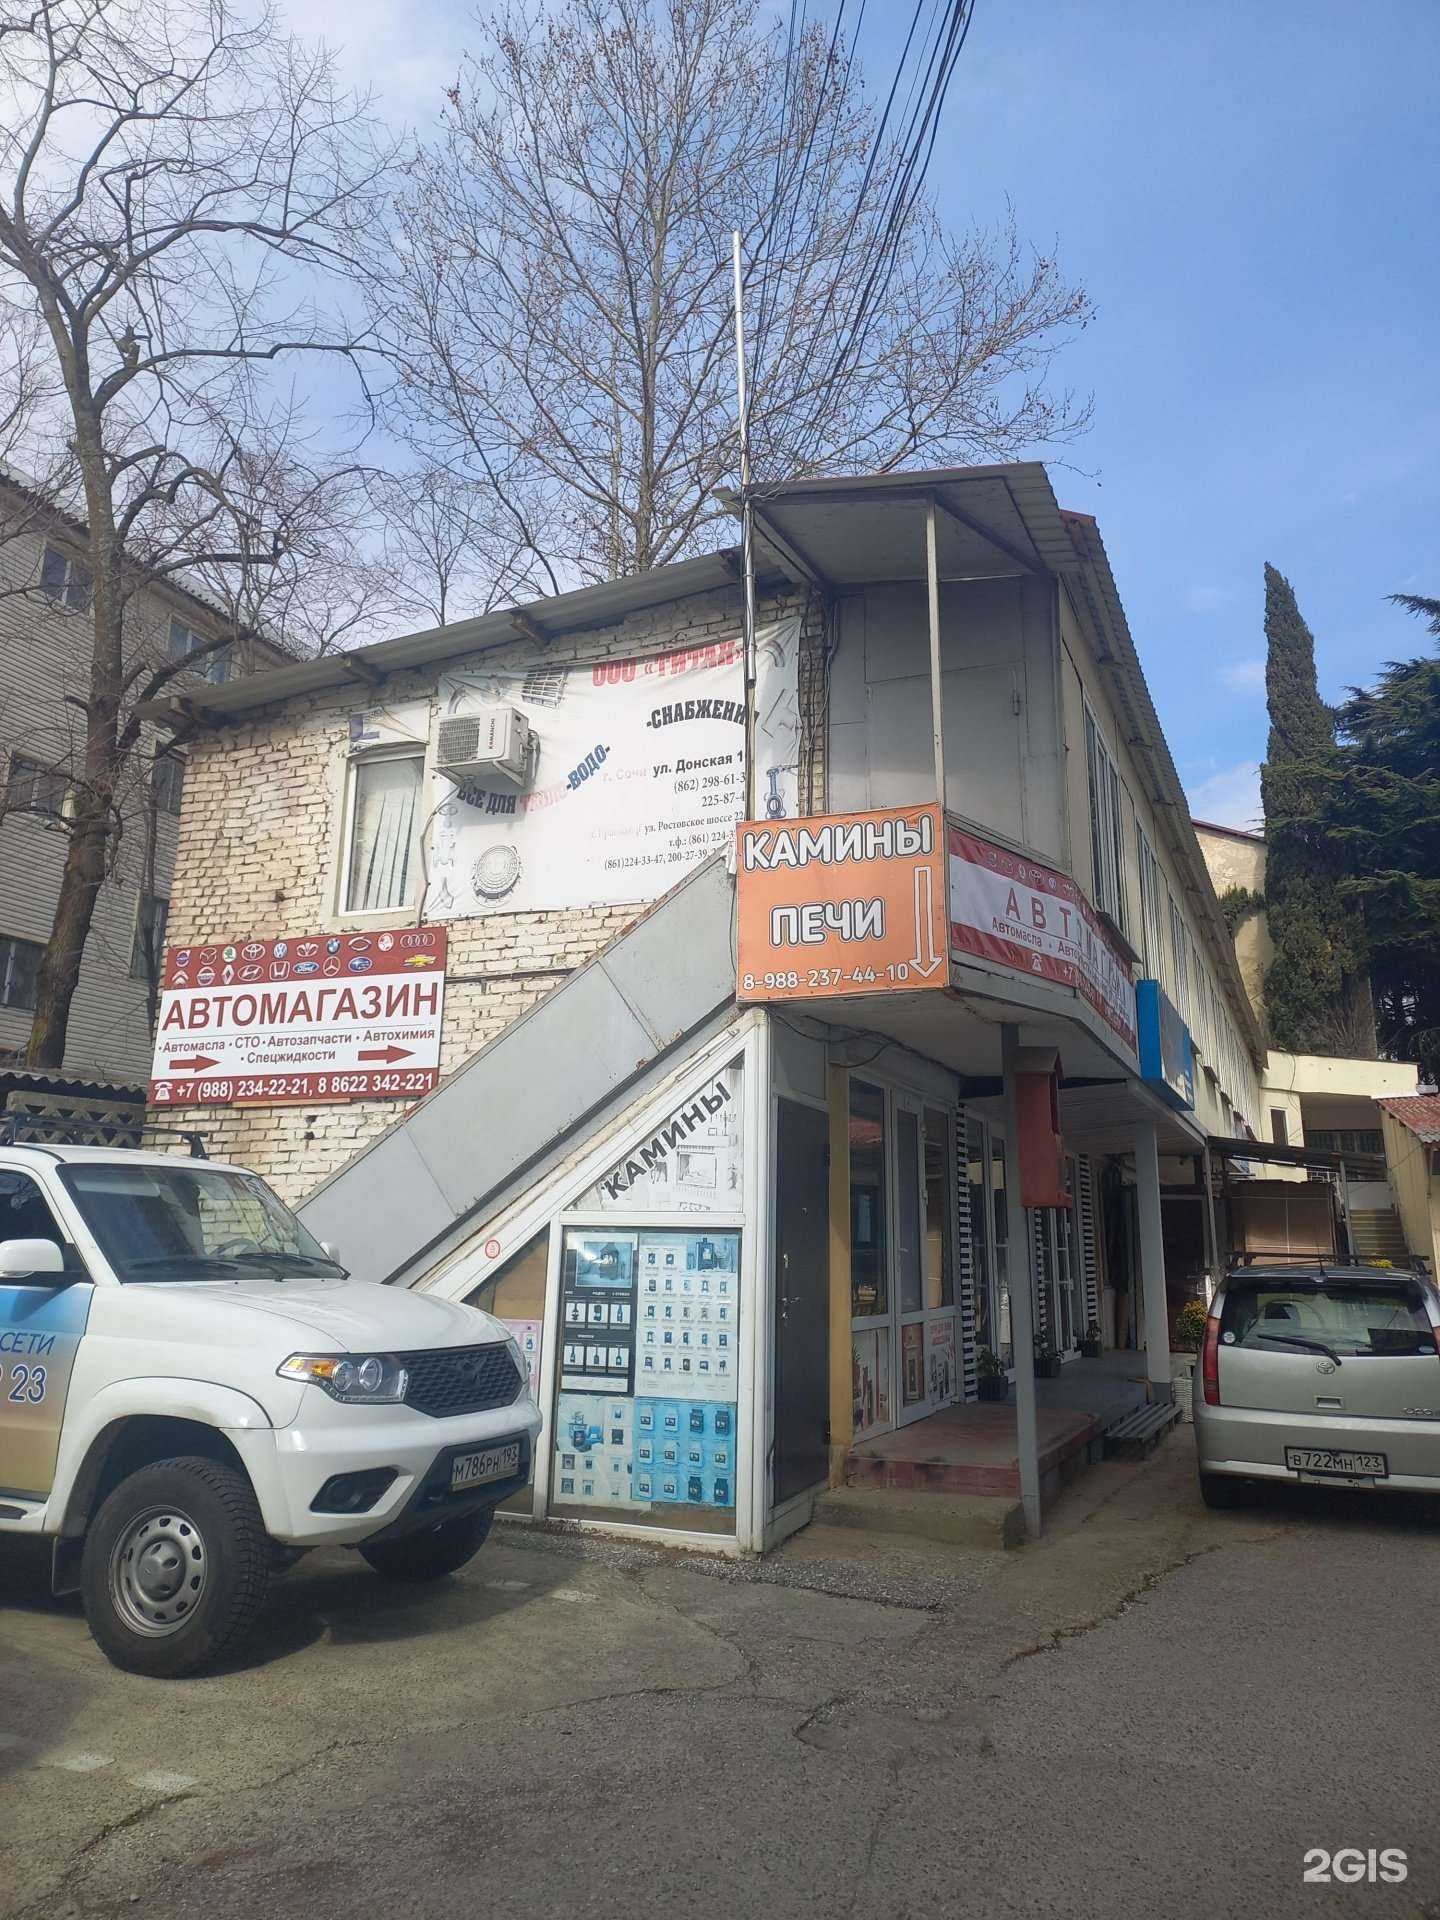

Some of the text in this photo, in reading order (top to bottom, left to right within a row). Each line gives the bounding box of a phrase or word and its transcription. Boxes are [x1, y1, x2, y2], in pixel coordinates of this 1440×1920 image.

[592, 658, 637, 687] ООО
[653, 764, 672, 778] ул.
[675, 753, 733, 774] Донская
[674, 777, 699, 794] (862)
[485, 791, 517, 815] ДЛЯ
[657, 817, 705, 832] Ростовское
[706, 814, 733, 825] шоссе
[688, 831, 709, 846] (861)
[743, 814, 934, 873] КАМИНЫ
[770, 897, 885, 949] ПЕЧИ
[992, 917, 1042, 948] Автомасла
[743, 963, 909, 990] 8-988-237-44-10
[162, 982, 438, 1031] АВТОМАГАЗИН
[162, 1029, 435, 1053] Автомасла СТО Автозапчасти Автохимия
[247, 1050, 336, 1065] Спецжидкости
[176, 1072, 433, 1102] +7 (988) 234-22-21, 8 8622 342-221
[601, 1081, 732, 1200] КАМИНЫ
[8, 1363, 47, 1405] 23
[1293, 1452, 1380, 1471] В722МН 123
